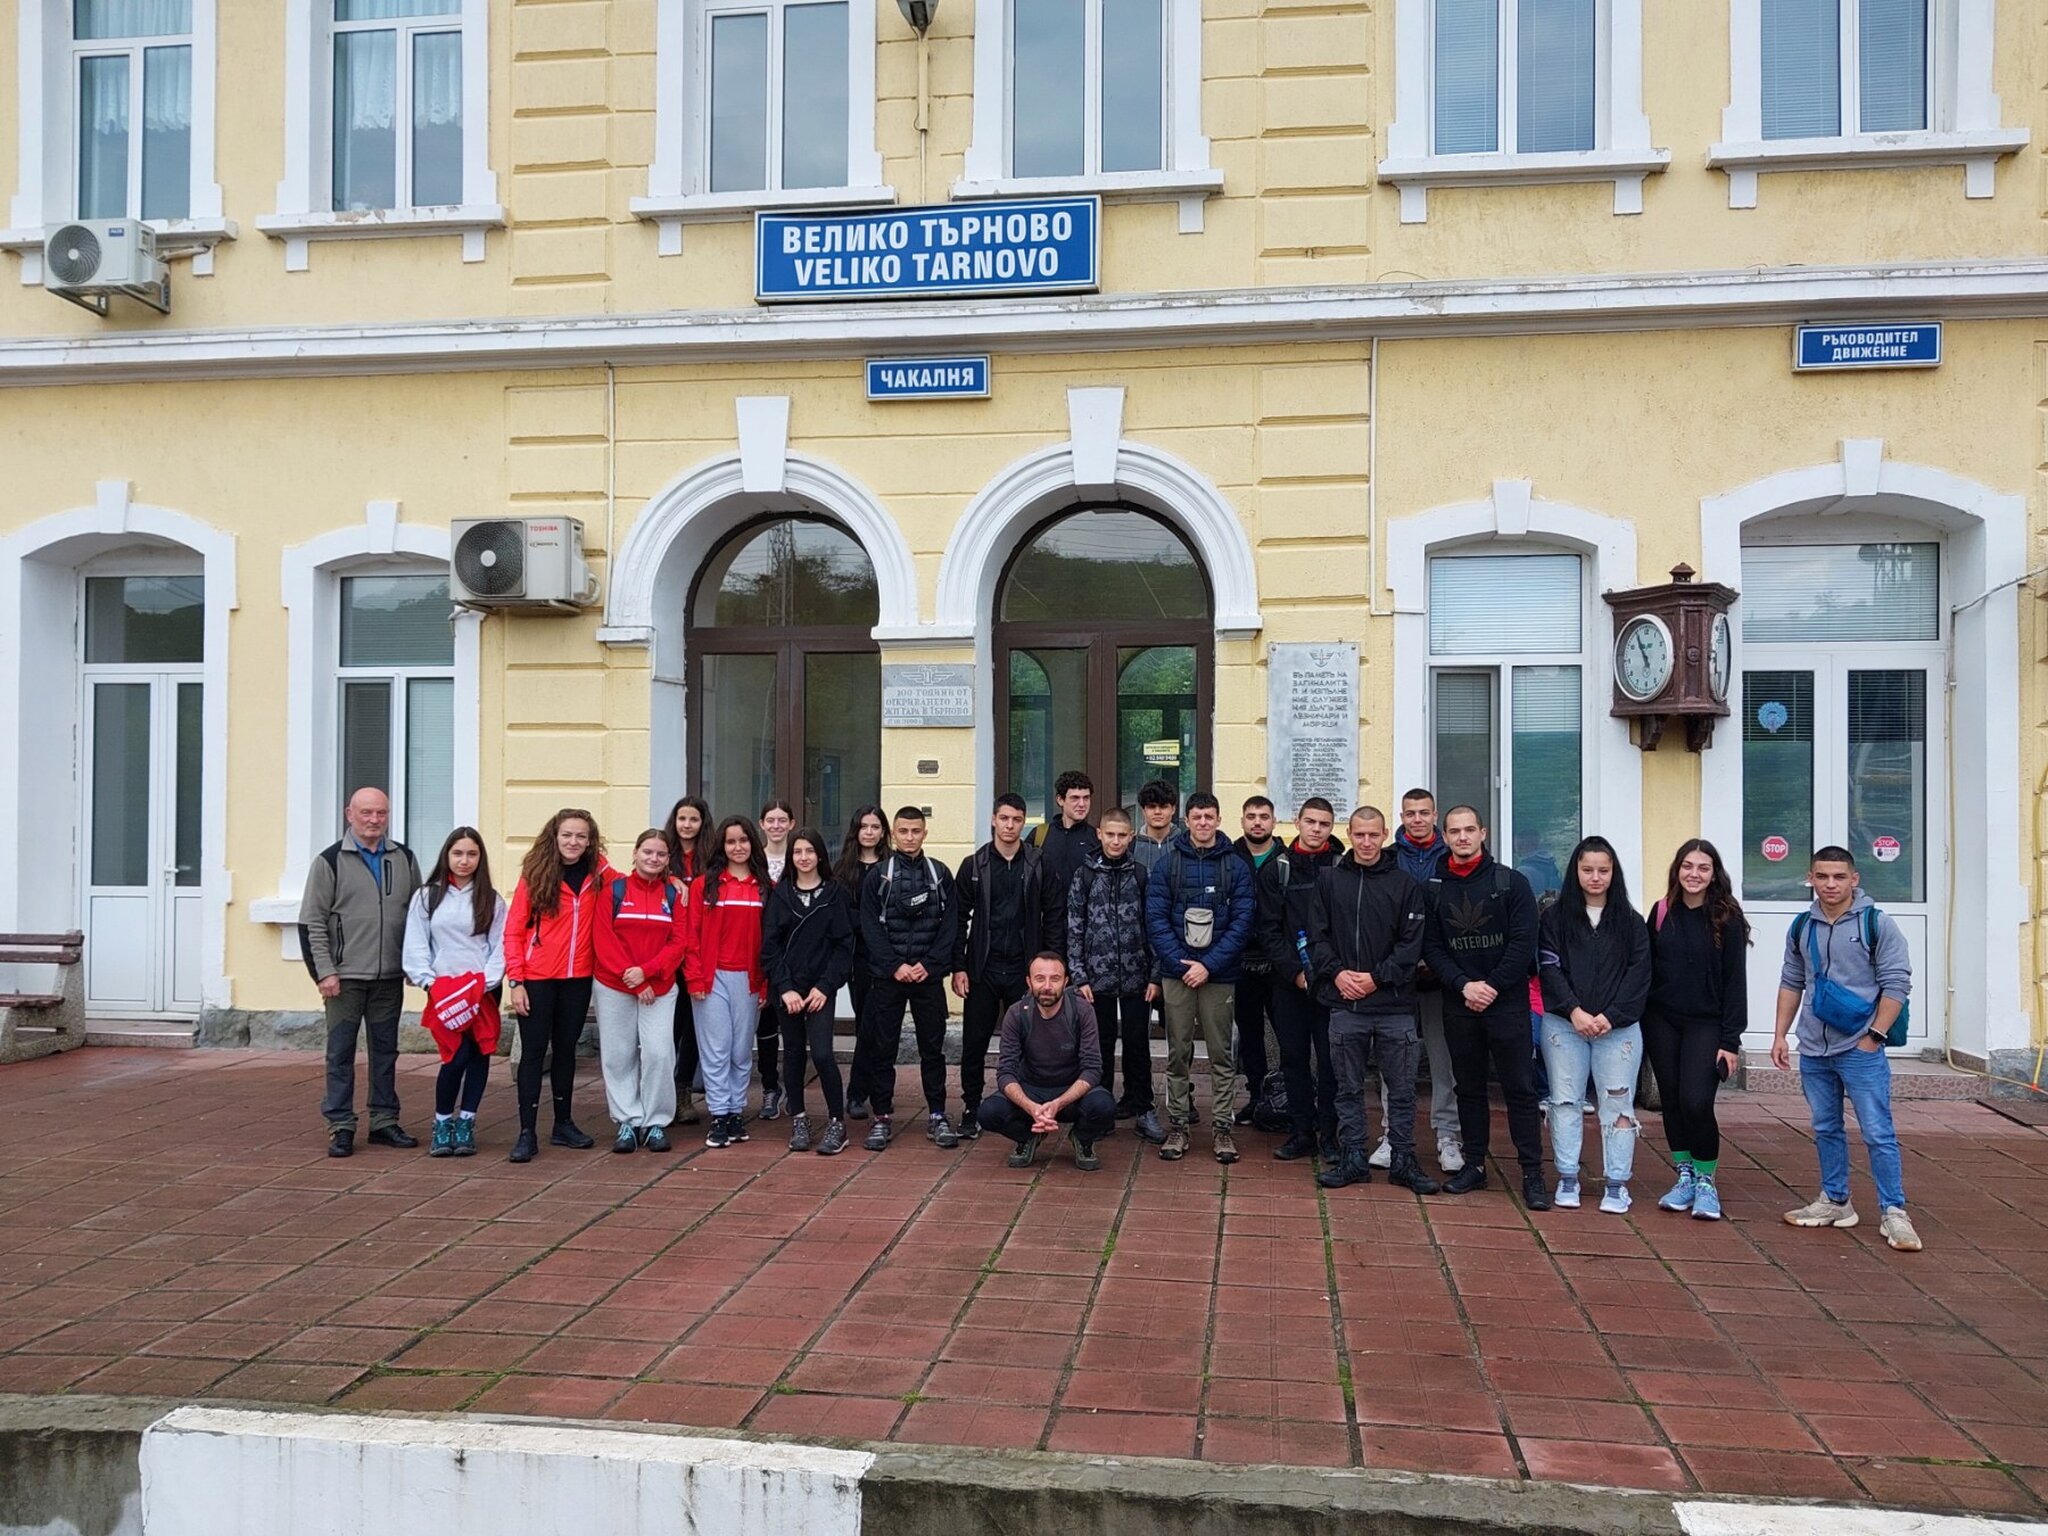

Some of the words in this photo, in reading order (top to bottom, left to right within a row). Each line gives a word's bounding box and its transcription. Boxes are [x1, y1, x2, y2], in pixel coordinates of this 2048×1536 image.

[783, 220, 909, 255] ВЕЛИКО
[920, 211, 1073, 247] ТЪРНОВО
[794, 254, 901, 287] VELIKO
[912, 247, 1059, 282] TARNOVO
[1822, 331, 1919, 346] РЪКОВОДИТЕЛ
[1832, 345, 1908, 361] ДВИЖЕНИЕ
[881, 367, 975, 389] ЧАКАЛНЯ
[886, 698, 951, 706] ОТКРИВАНЕТО
[1765, 844, 1786, 853] STOP
[1448, 932, 1504, 950] MSTERDAM
